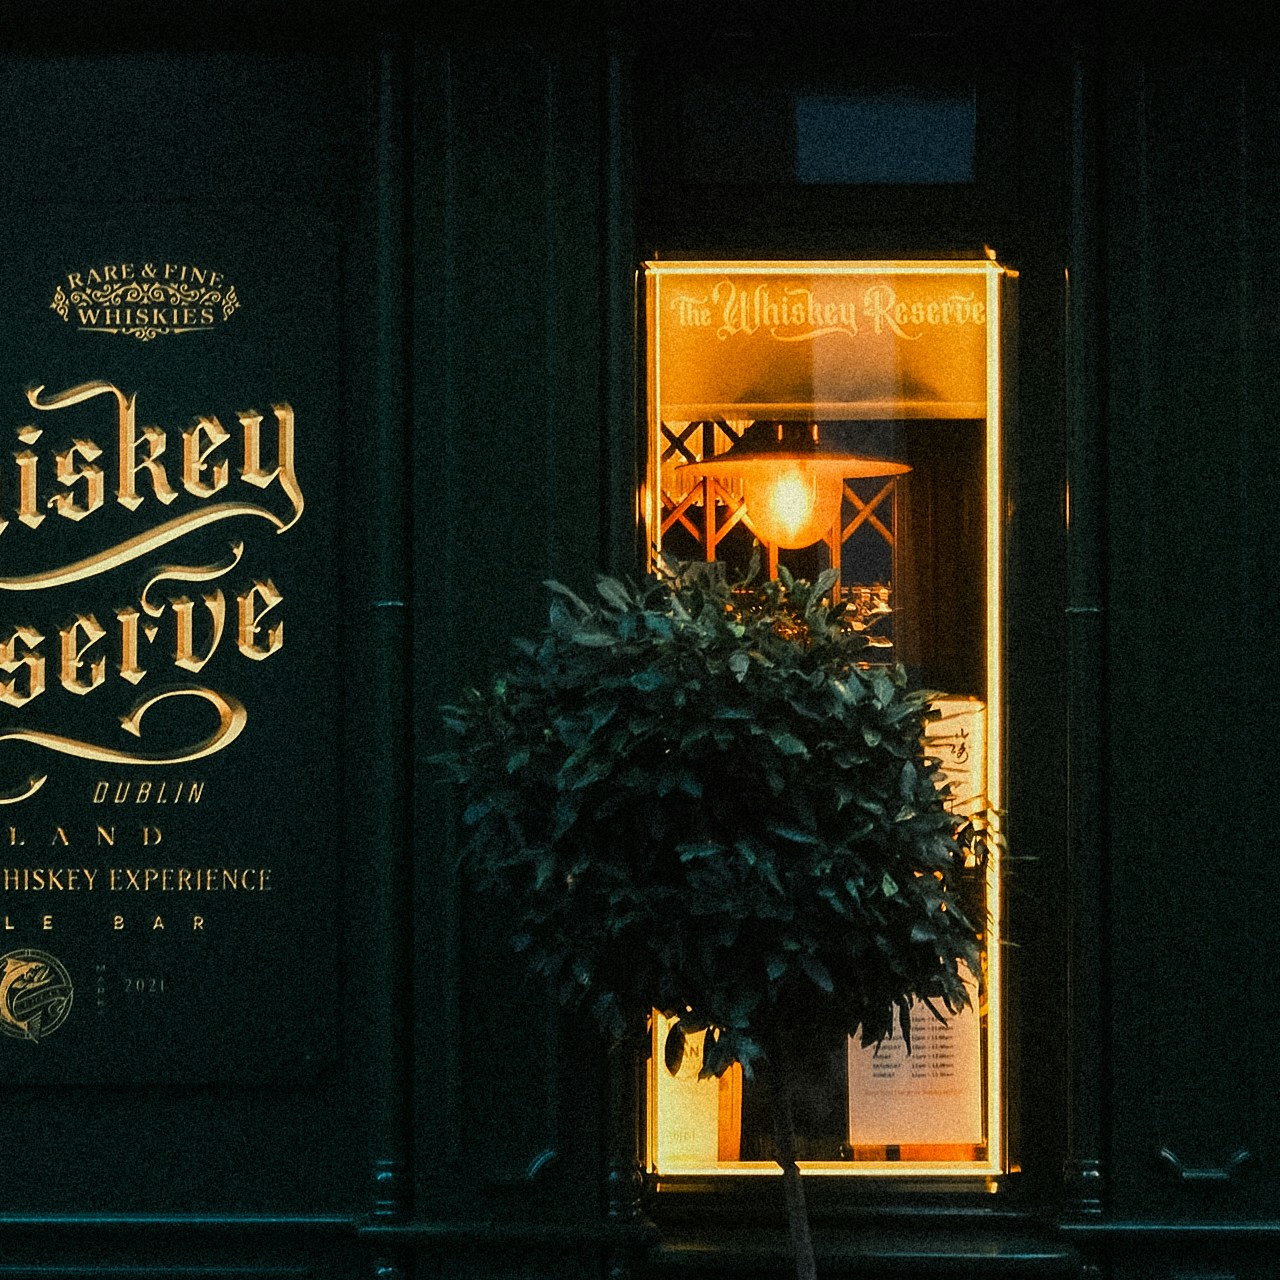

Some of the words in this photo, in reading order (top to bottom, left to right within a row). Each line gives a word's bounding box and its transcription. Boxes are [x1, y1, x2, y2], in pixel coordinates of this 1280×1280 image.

[67, 263, 135, 289] RARE
[141, 263, 157, 279] &
[165, 263, 224, 289] FINE
[78, 307, 215, 325] WHISKIES
[669, 294, 712, 328] The
[711, 278, 859, 342] Whiskey
[863, 284, 988, 341] Reserve
[92, 781, 207, 805] DUBLIN
[109, 867, 273, 891] EXPERIENCE
[113, 913, 206, 931] BAR
[123, 977, 167, 993] 2021
